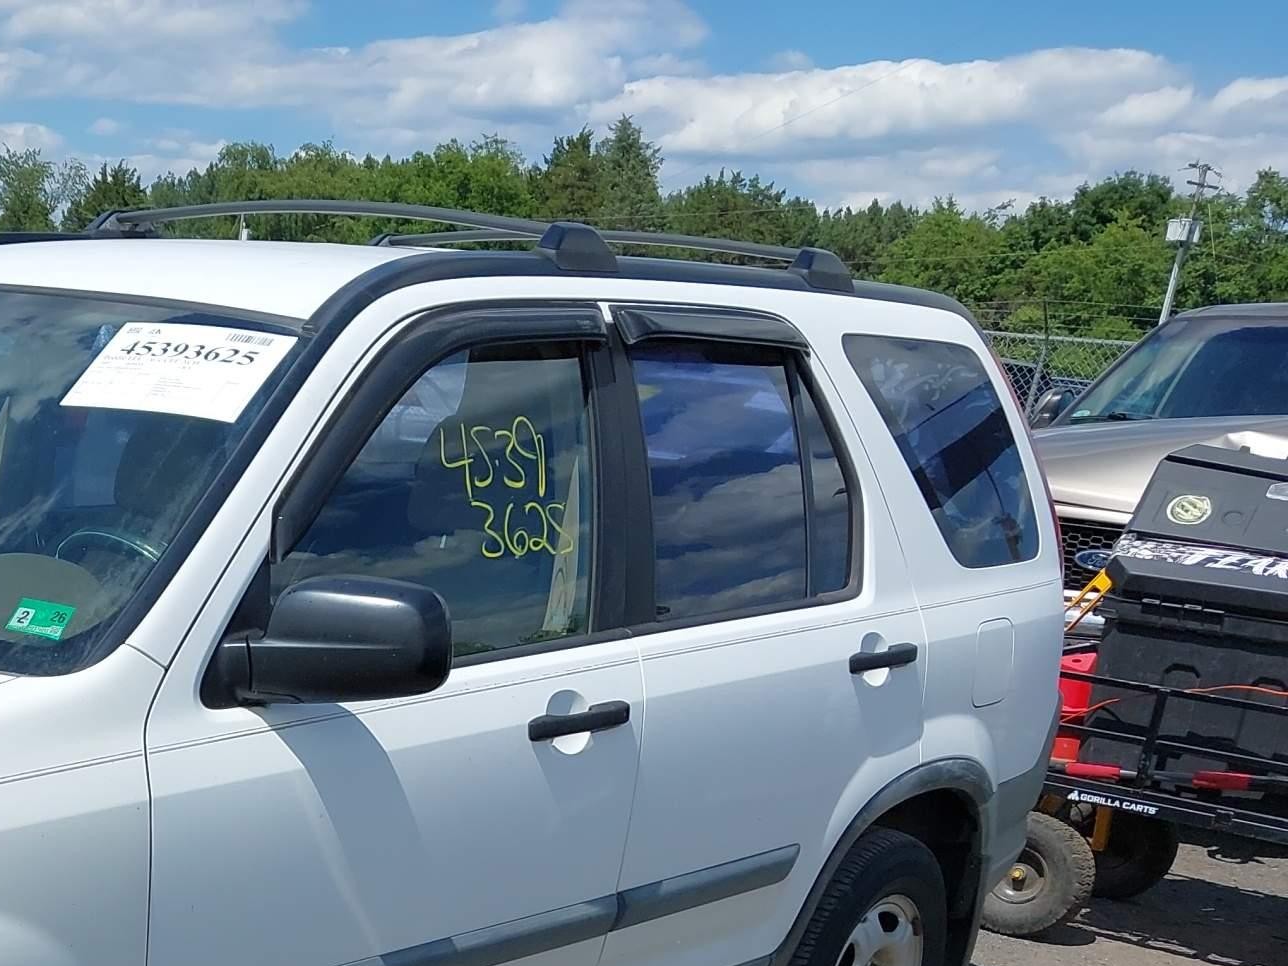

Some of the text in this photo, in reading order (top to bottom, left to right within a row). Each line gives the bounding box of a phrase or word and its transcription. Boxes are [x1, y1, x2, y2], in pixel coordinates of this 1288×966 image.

[120, 340, 260, 366] 45393625
[439, 416, 547, 498] 4539
[471, 501, 574, 559] 3625
[17, 610, 68, 624] 2 26
[1080, 793, 1159, 815] GORILLA CARTS
